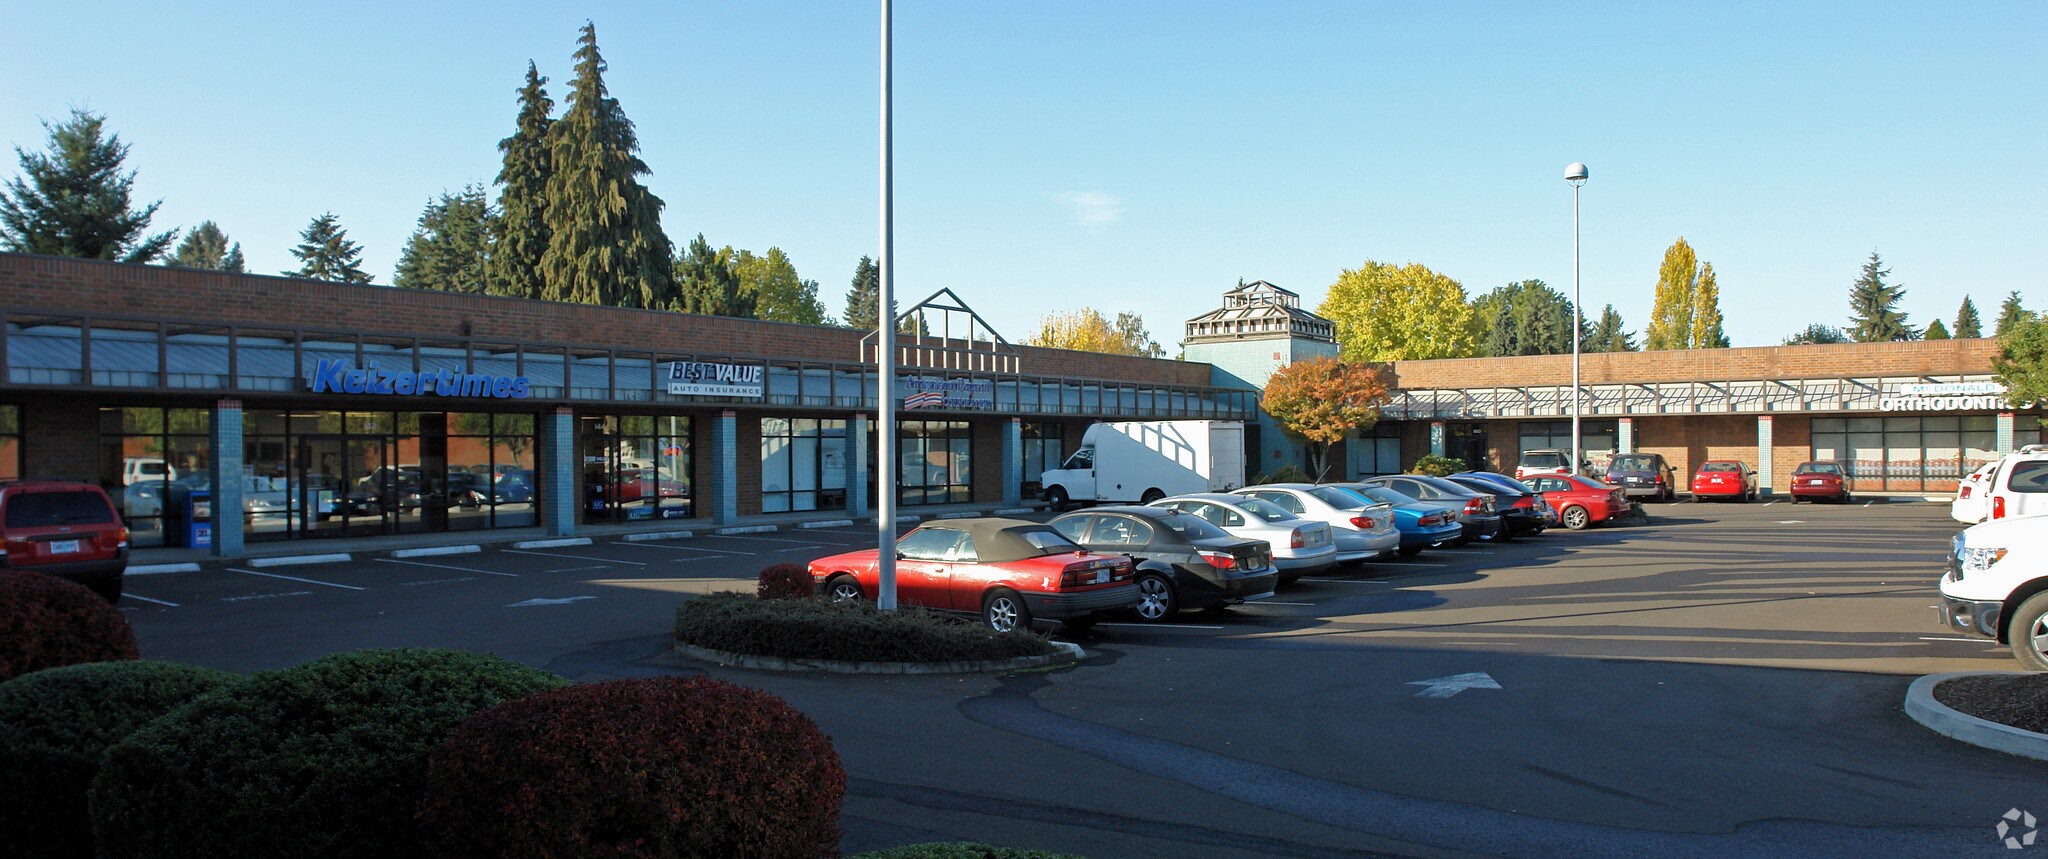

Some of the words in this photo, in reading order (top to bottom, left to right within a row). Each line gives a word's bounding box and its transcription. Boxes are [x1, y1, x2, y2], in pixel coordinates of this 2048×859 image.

[313, 358, 529, 399] Keizertimes
[669, 361, 716, 380] BEST
[715, 364, 761, 383] VALUE
[704, 387, 760, 395] INSURANCE
